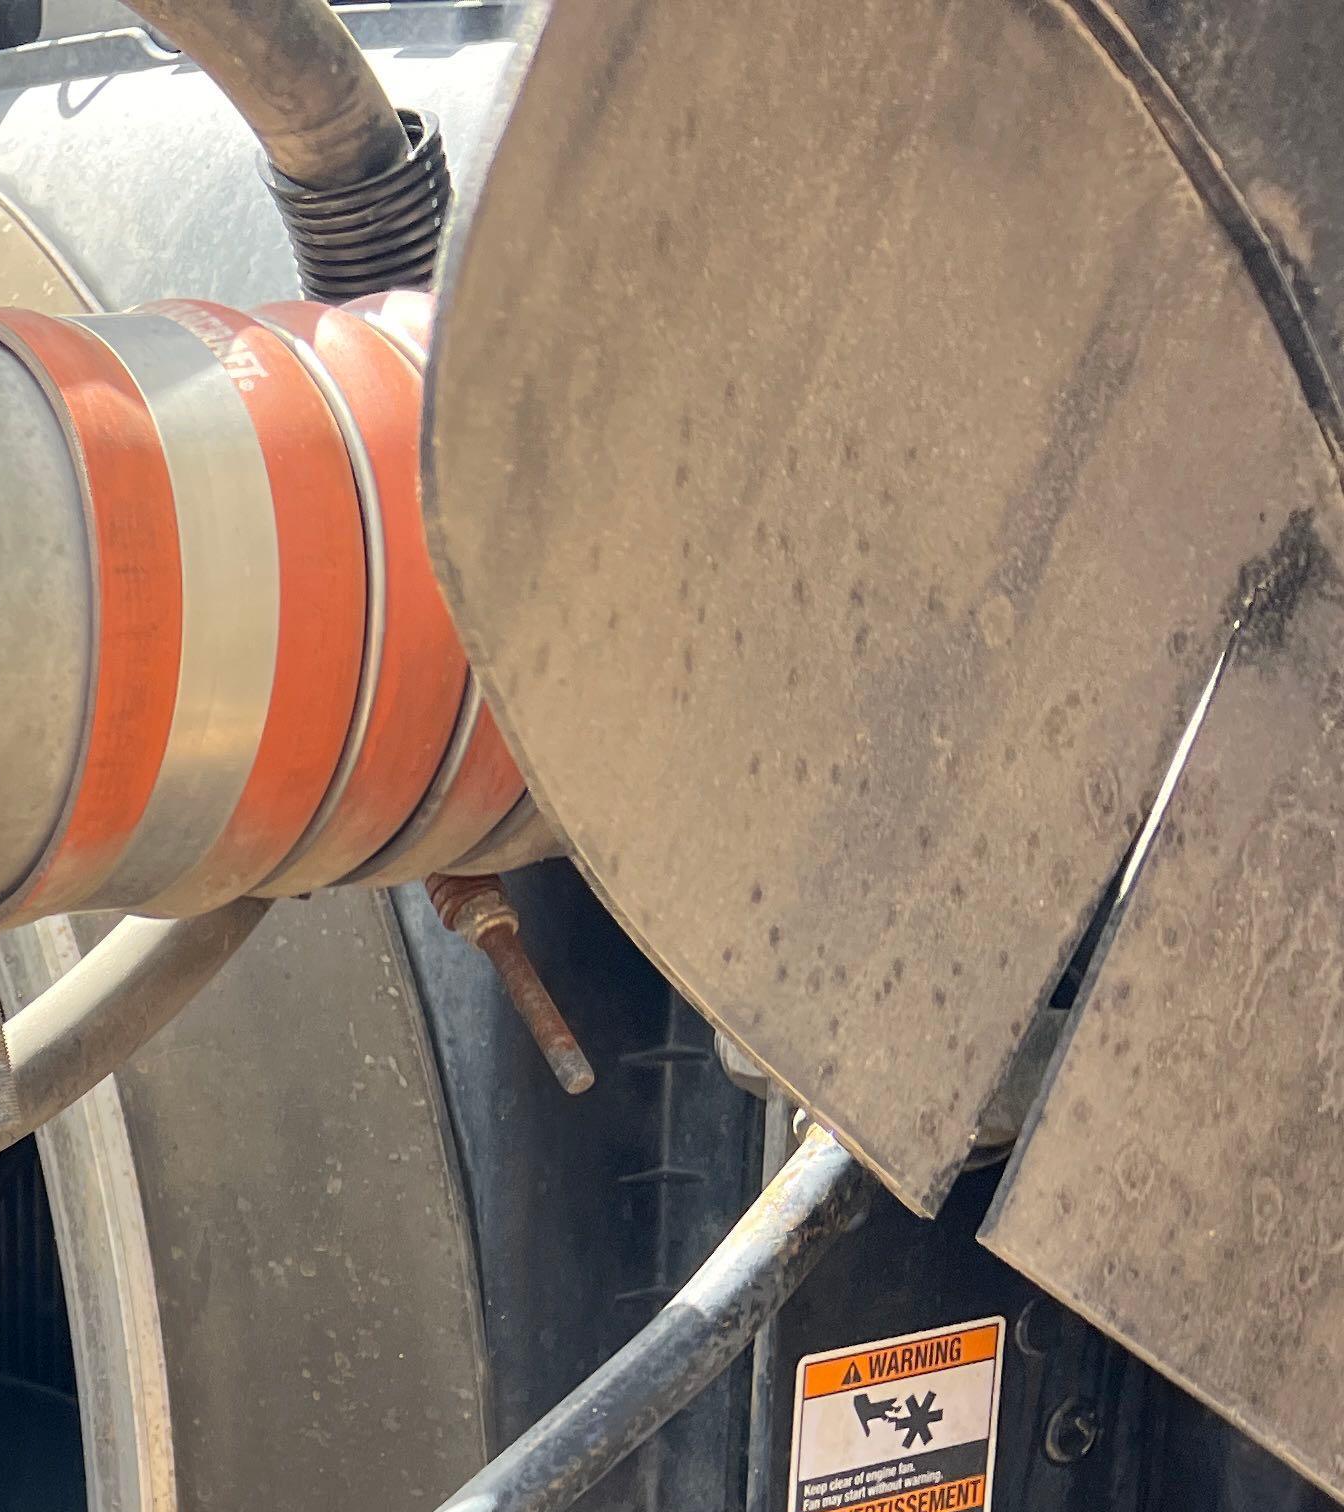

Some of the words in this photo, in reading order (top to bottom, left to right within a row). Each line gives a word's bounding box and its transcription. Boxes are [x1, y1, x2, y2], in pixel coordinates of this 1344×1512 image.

[868, 1336, 962, 1380] WARNING
[802, 1498, 821, 1512] Fan
[821, 1492, 843, 1507] may
[844, 1487, 866, 1503] start
[867, 1479, 903, 1497] without
[904, 1470, 944, 1488] warning.
[803, 1483, 828, 1498] Keep
[829, 1477, 853, 1493] clear
[854, 1472, 865, 1486] of
[865, 1466, 897, 1485] engine
